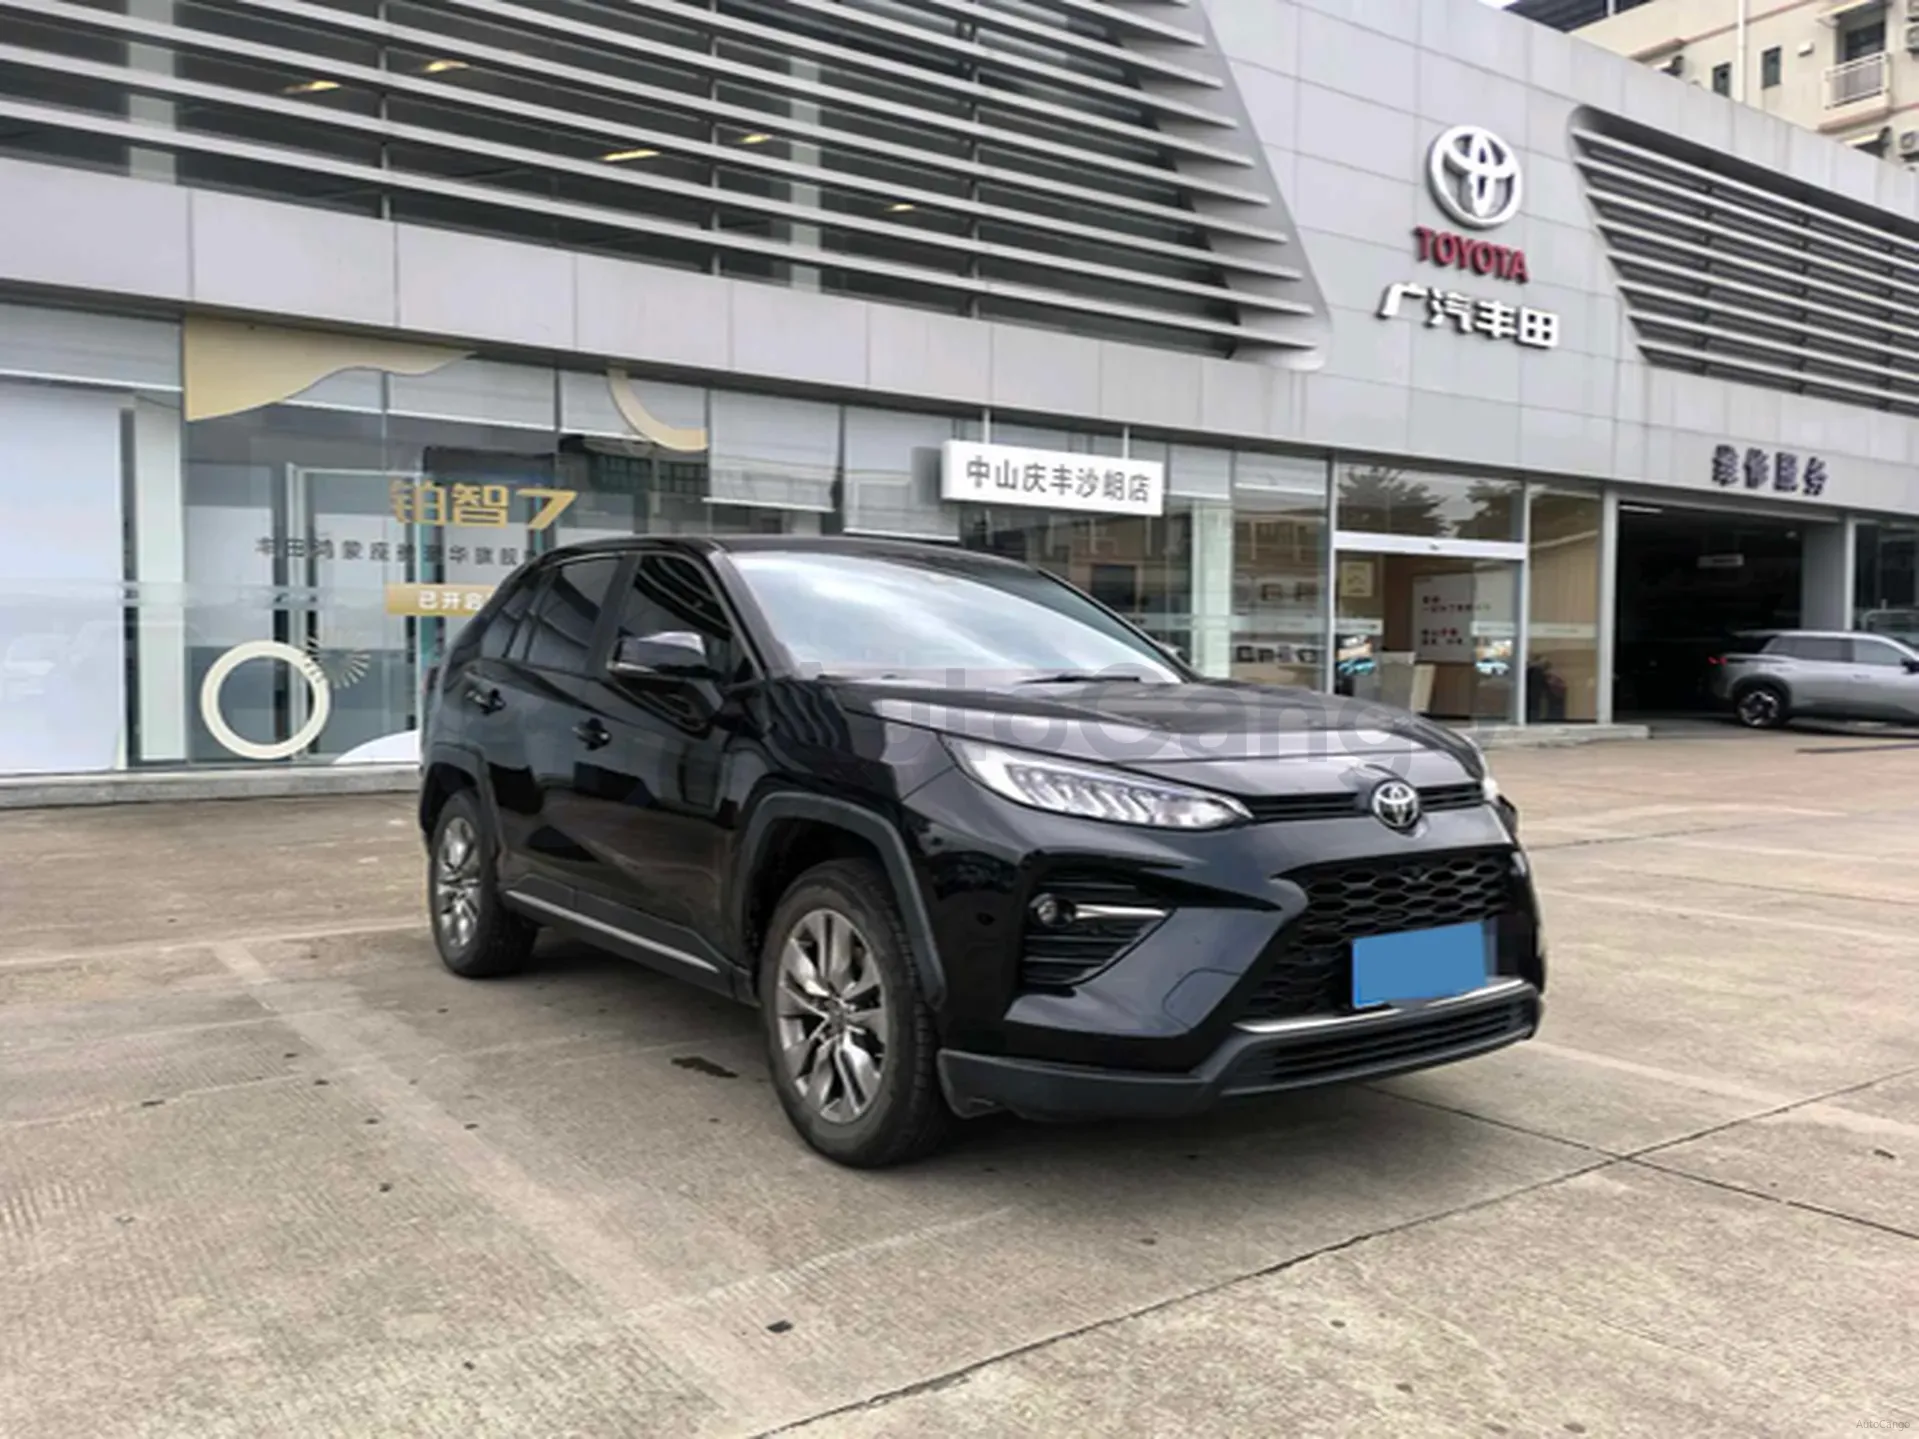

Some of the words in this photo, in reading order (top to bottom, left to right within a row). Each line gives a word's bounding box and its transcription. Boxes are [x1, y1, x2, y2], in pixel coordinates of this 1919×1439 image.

[1412, 225, 1528, 284] TOYOTA
[1377, 282, 1560, 349] 广汽丰田
[389, 480, 578, 531] 铂智7
[418, 590, 494, 611] 已开启
